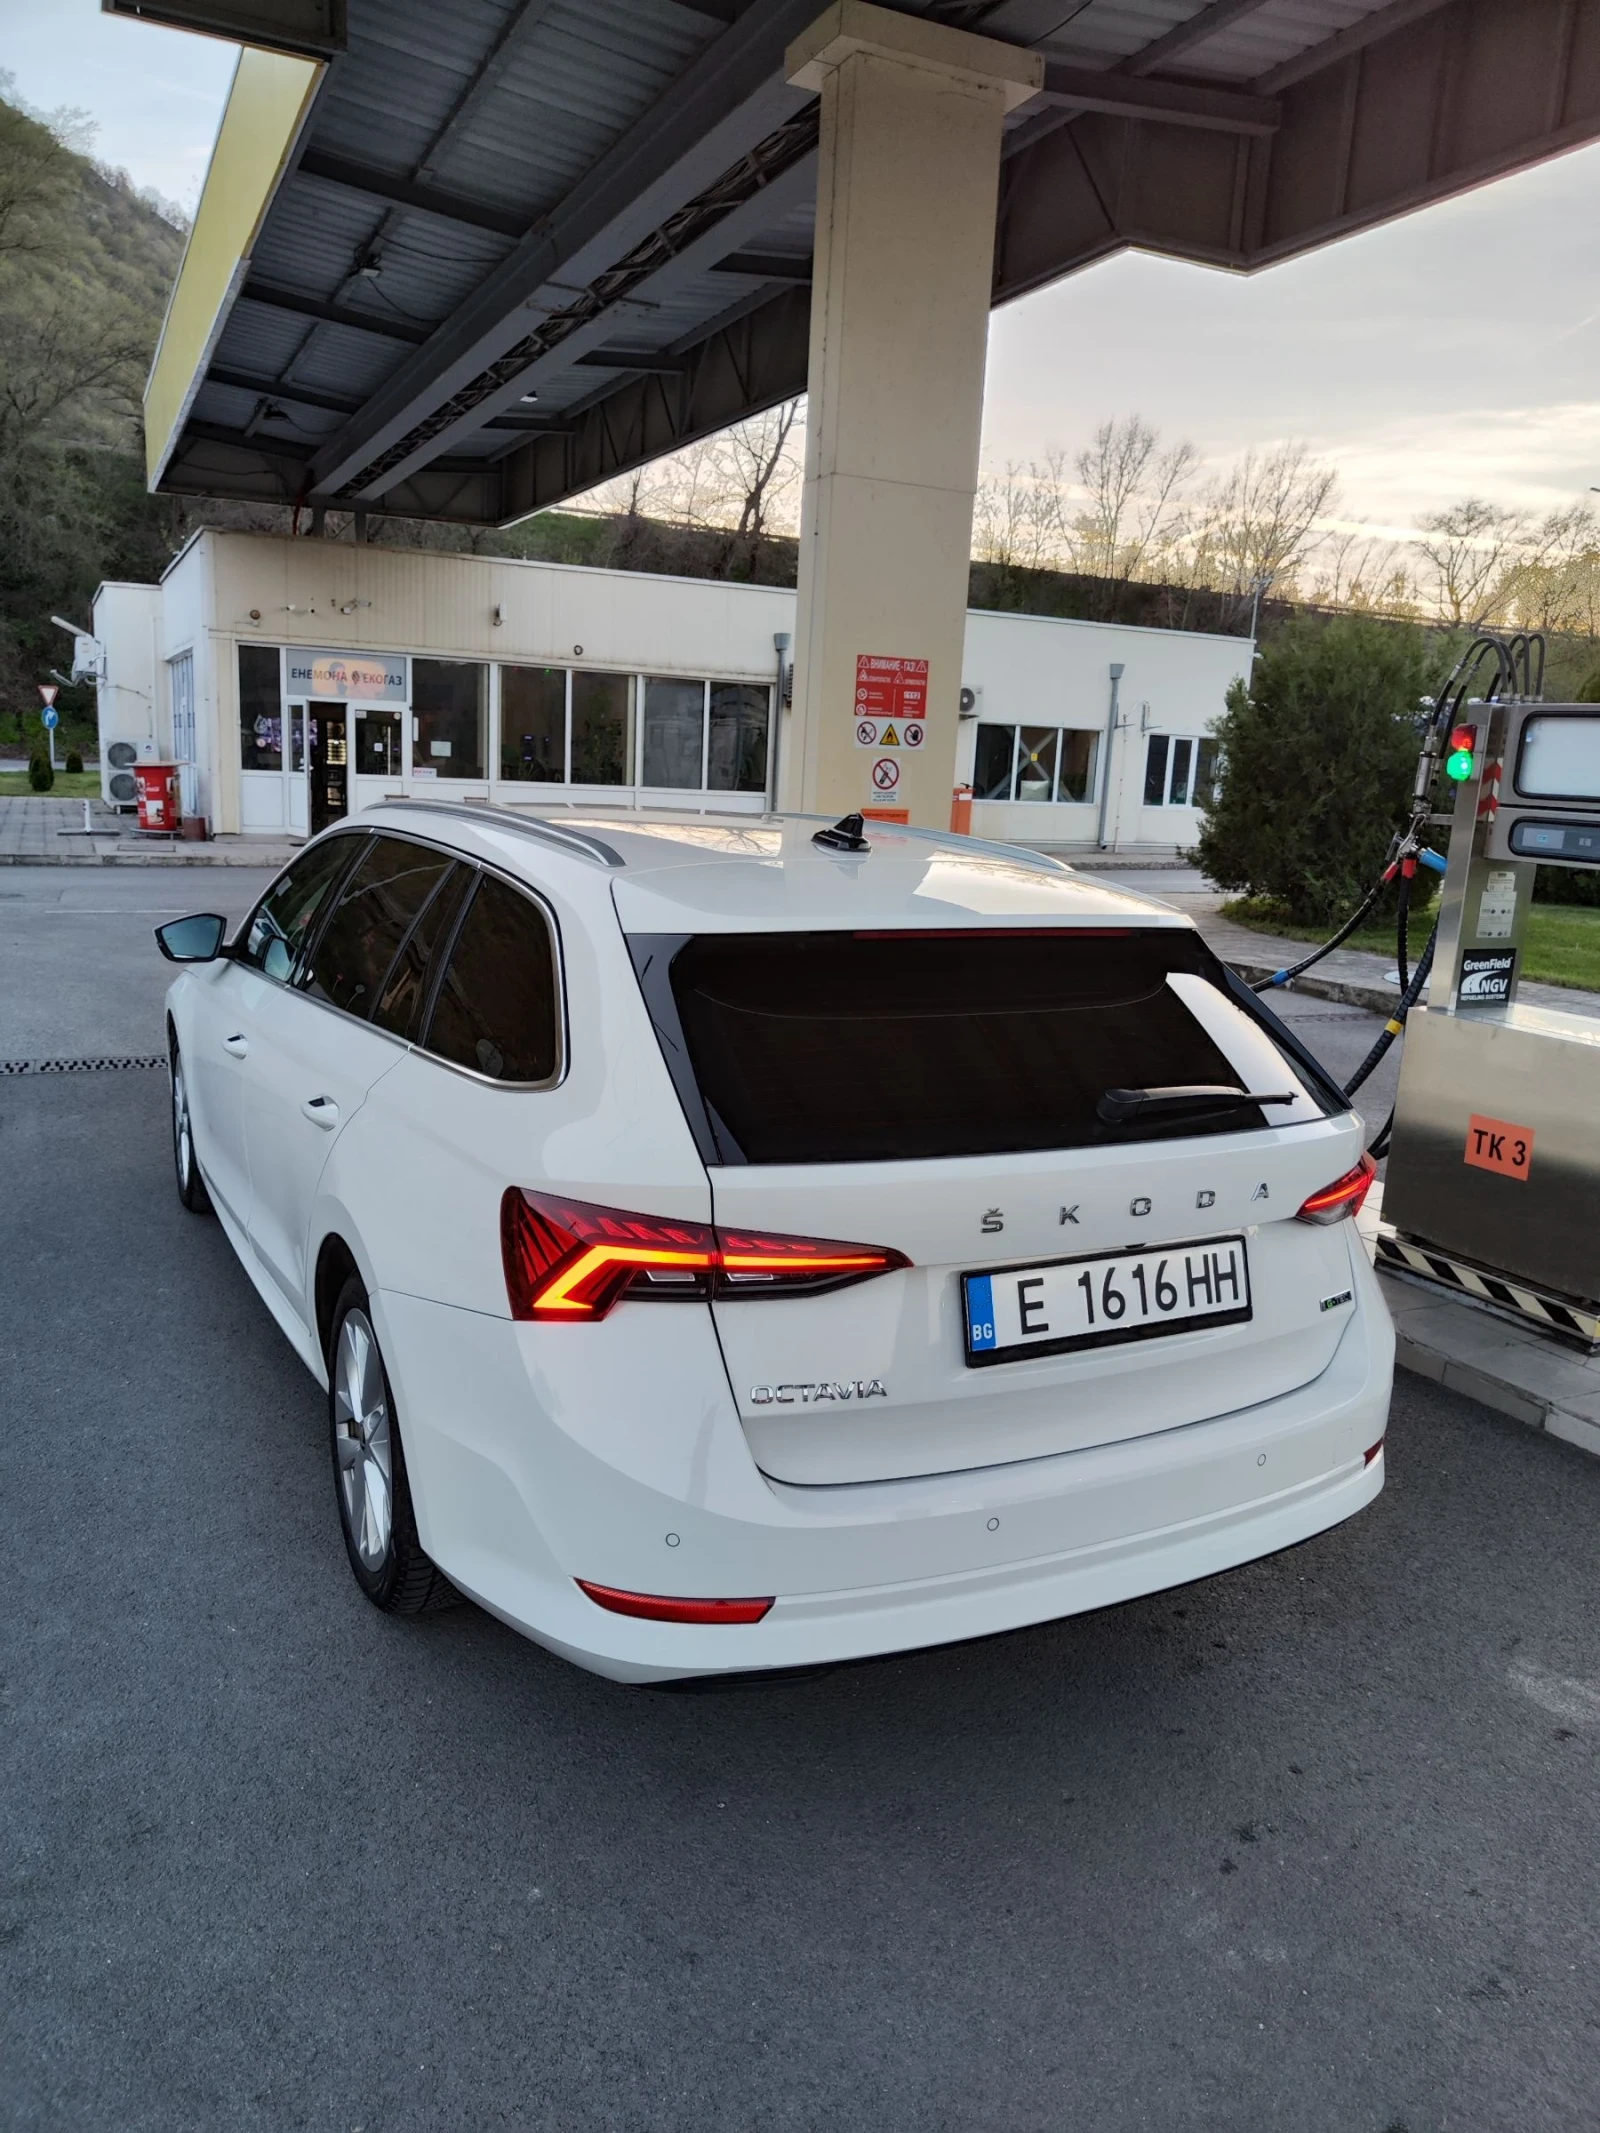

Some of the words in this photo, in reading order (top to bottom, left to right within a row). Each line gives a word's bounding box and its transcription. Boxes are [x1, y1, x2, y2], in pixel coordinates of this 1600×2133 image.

[871, 659, 901, 670] ВНИМАНИЕ
[292, 668, 347, 682] ЕНЕМОНА
[363, 673, 402, 686] ЕКОГАЗ
[1463, 958, 1511, 971] GreenField
[1480, 979, 1508, 993] NGV
[1512, 1140, 1526, 1167] 3
[980, 1181, 1269, 1233] ŠKODA
[1017, 1277, 1049, 1335] E
[972, 1323, 993, 1341] BG
[750, 1379, 887, 1405] OCTAVIA
